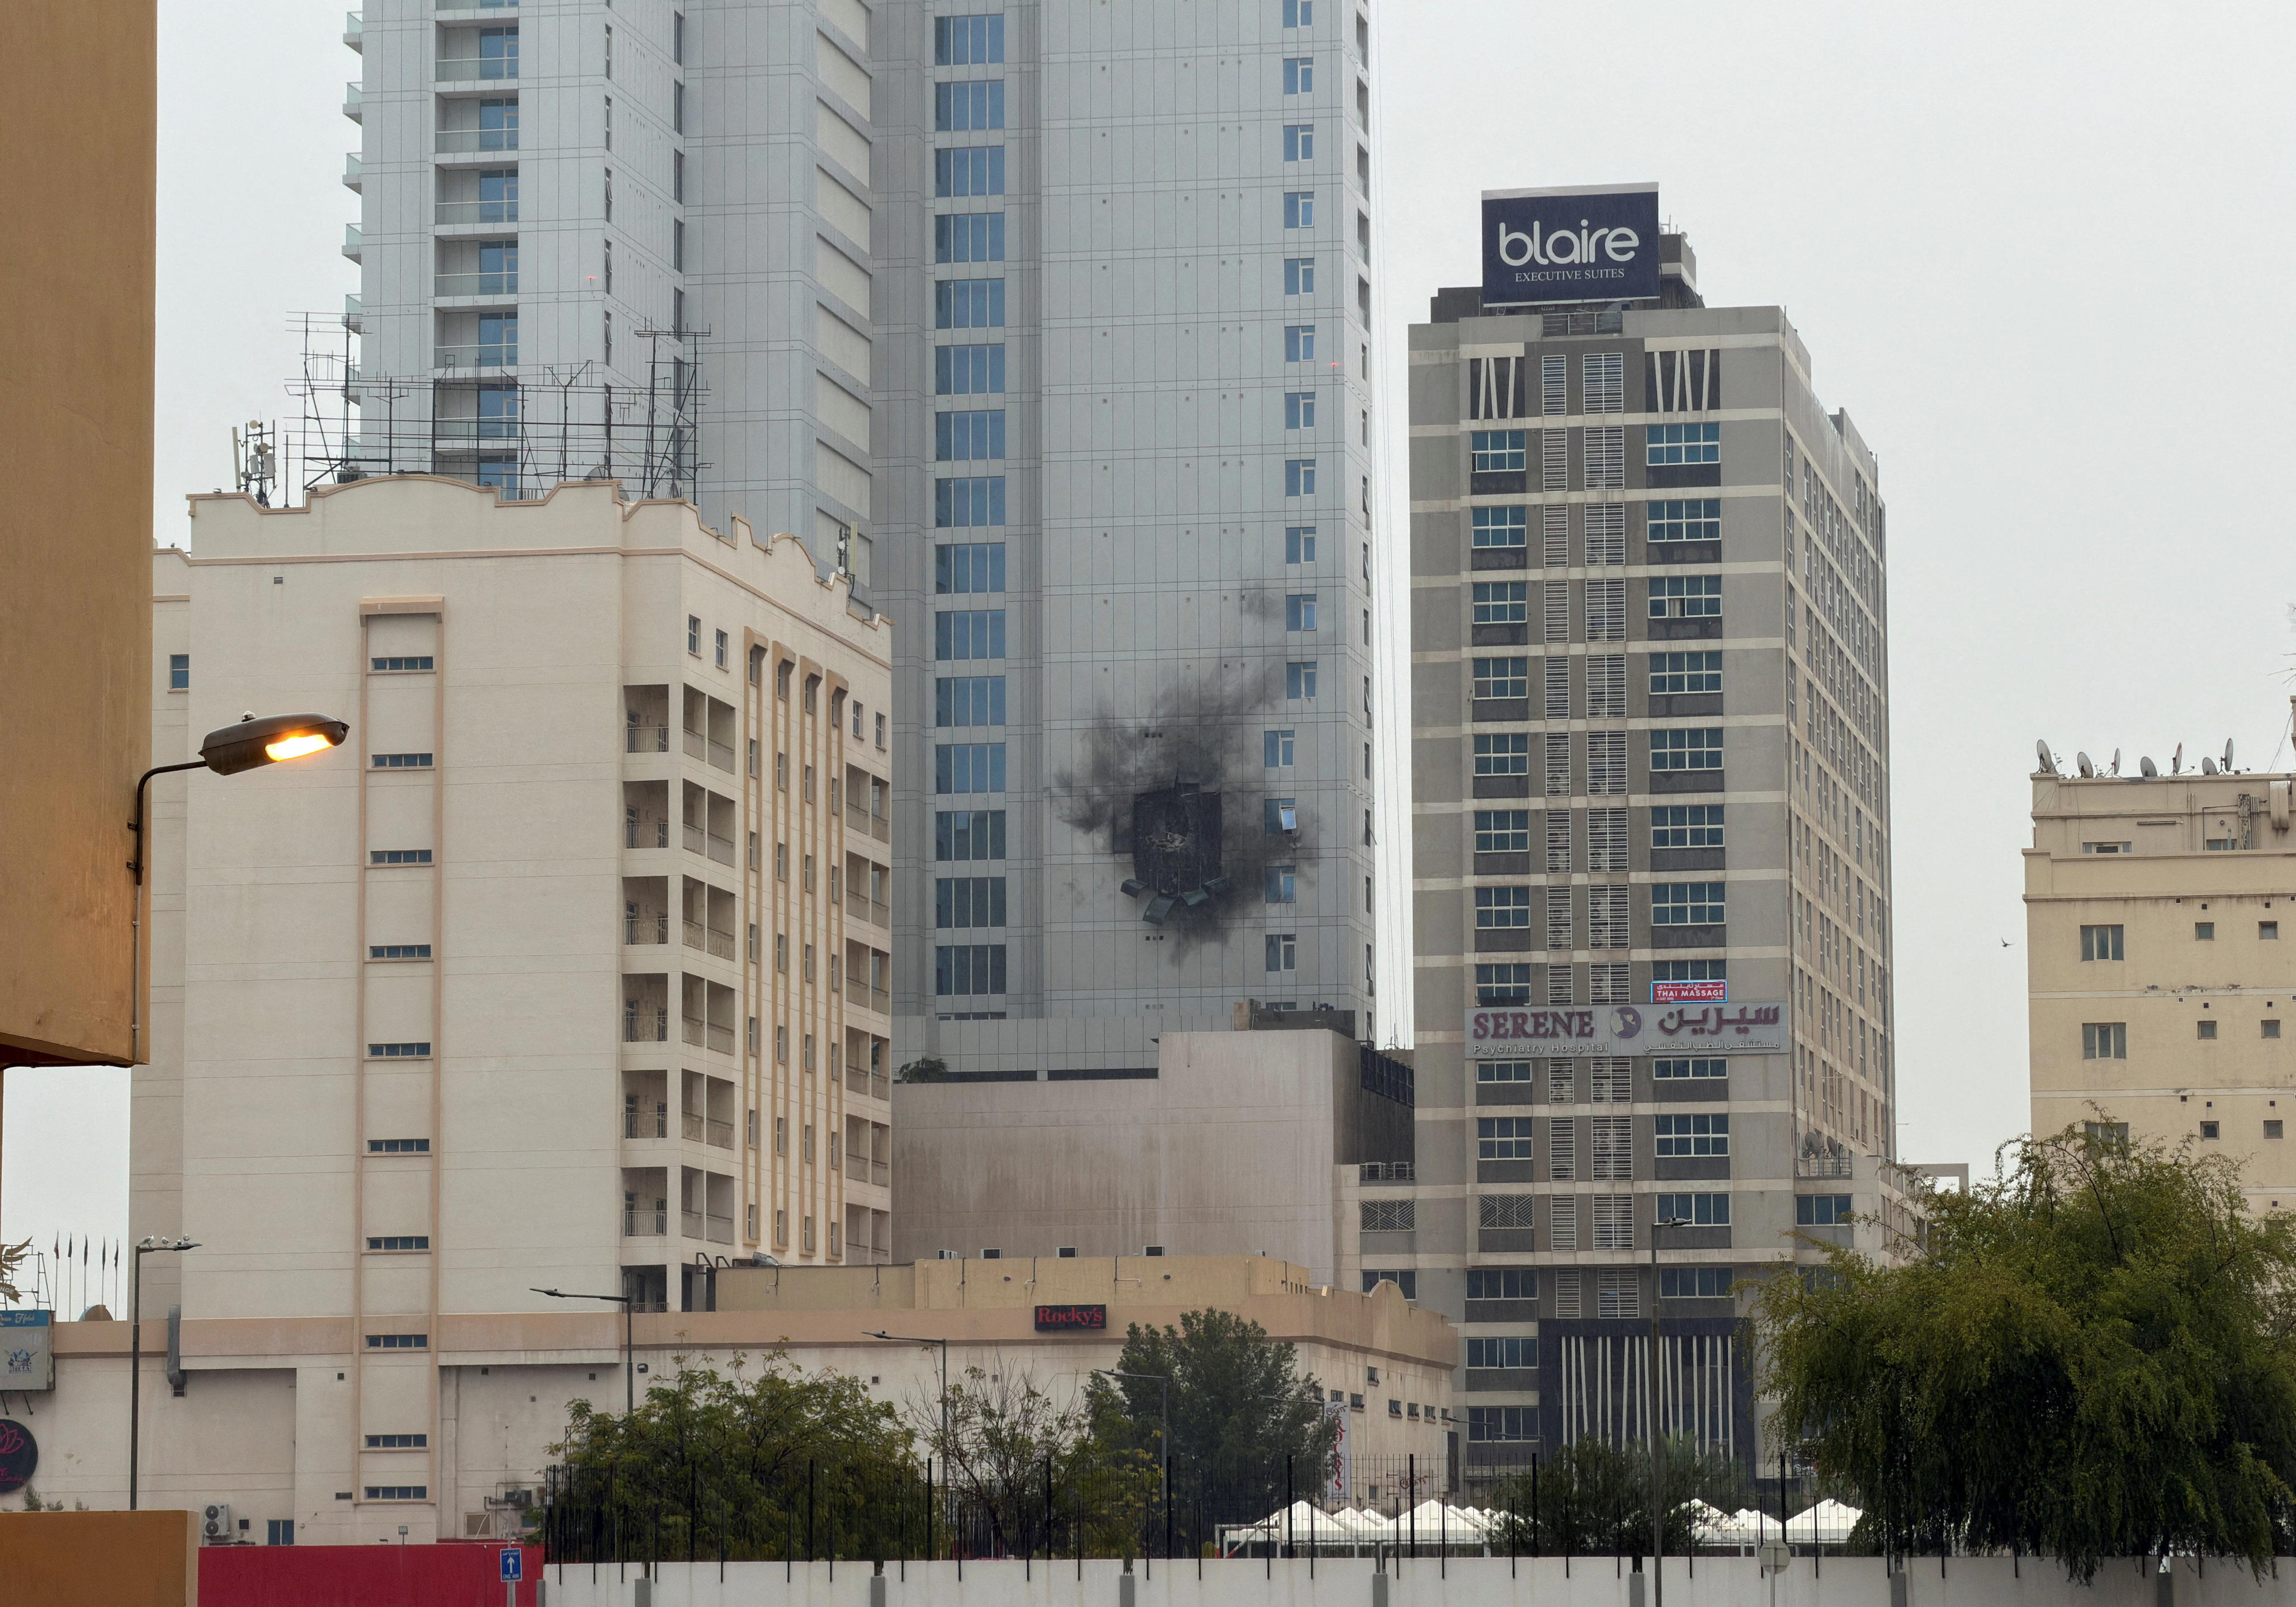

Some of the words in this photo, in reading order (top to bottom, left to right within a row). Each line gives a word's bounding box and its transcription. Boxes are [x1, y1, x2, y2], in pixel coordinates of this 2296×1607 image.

[1499, 219, 1639, 266] blaire
[1515, 271, 1581, 282] EXECUTIVE
[1584, 268, 1624, 279] SUITES
[1473, 1011, 1595, 1039] SERENE
[1658, 1006, 1779, 1035] سيرين
[1473, 1043, 1544, 1055] Psychiatry
[1551, 1043, 1609, 1054] Hospital
[1692, 1040, 1724, 1051] الطب
[1725, 1039, 1779, 1050] مستشفى
[1038, 1307, 1103, 1326] Rocky's
